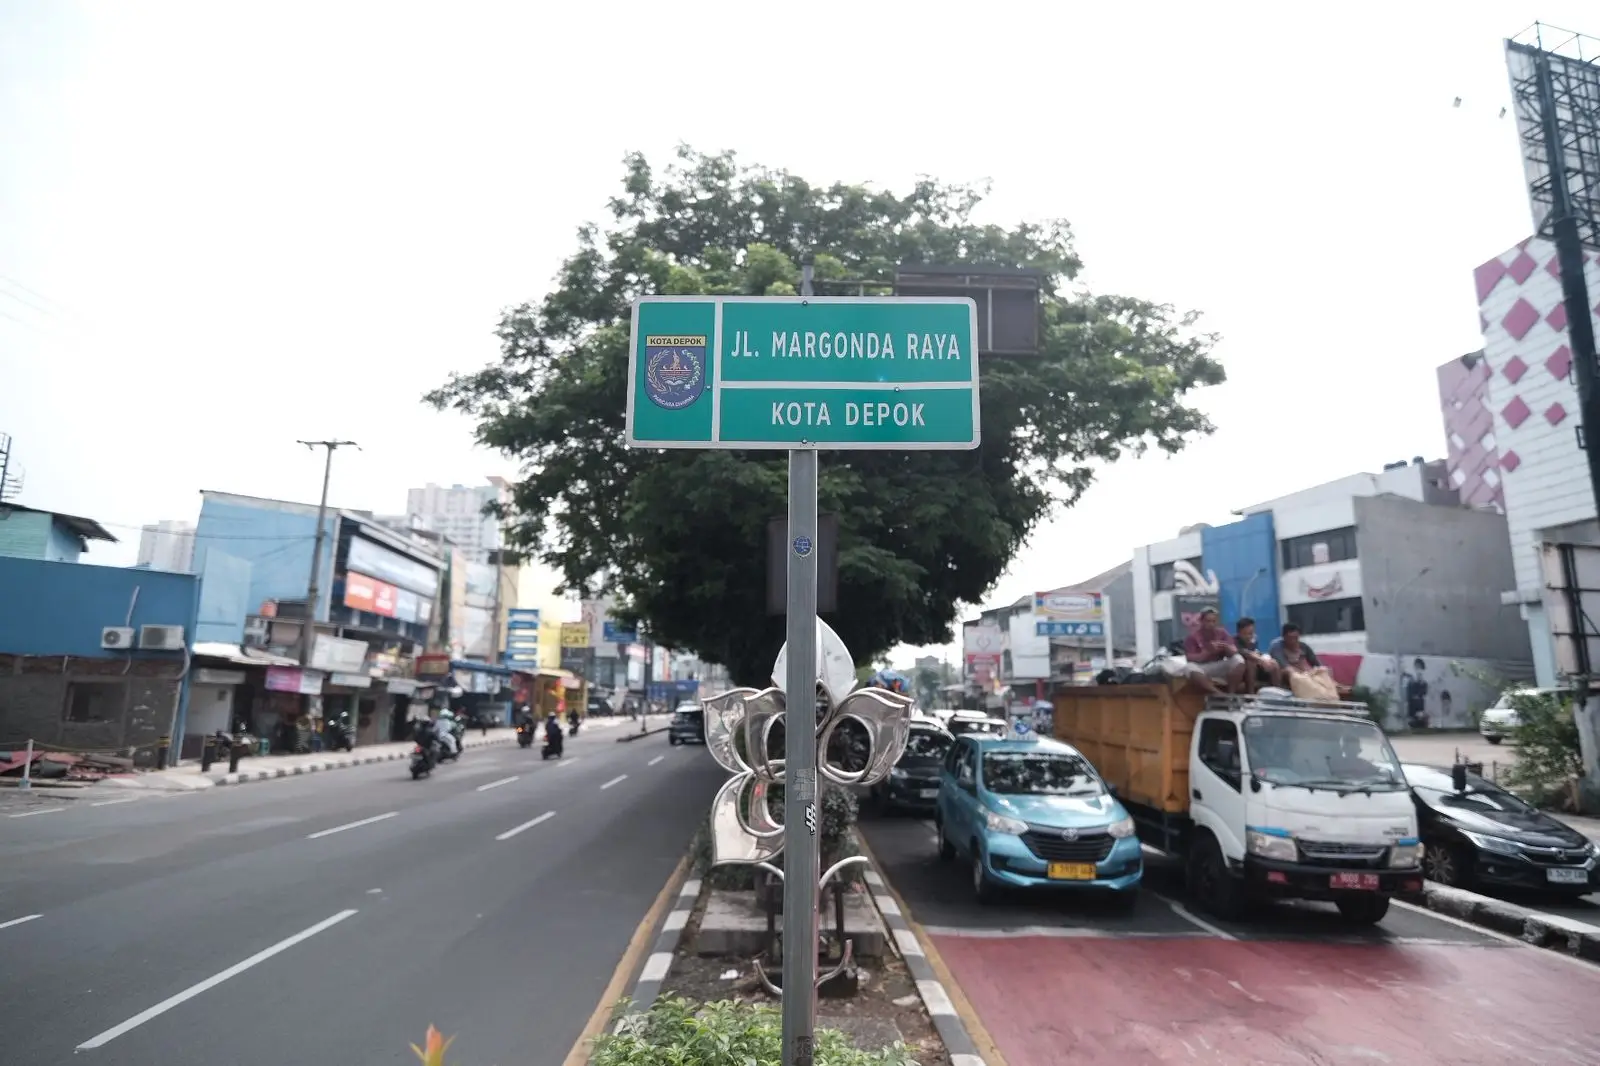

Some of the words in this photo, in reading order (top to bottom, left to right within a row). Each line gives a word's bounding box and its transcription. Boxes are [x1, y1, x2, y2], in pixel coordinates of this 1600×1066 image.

[731, 331, 759, 357] JL.
[771, 331, 895, 359] MARGONDA
[907, 333, 960, 360] RAYA
[772, 402, 831, 426] KOTA
[845, 402, 925, 426] DEPOK
